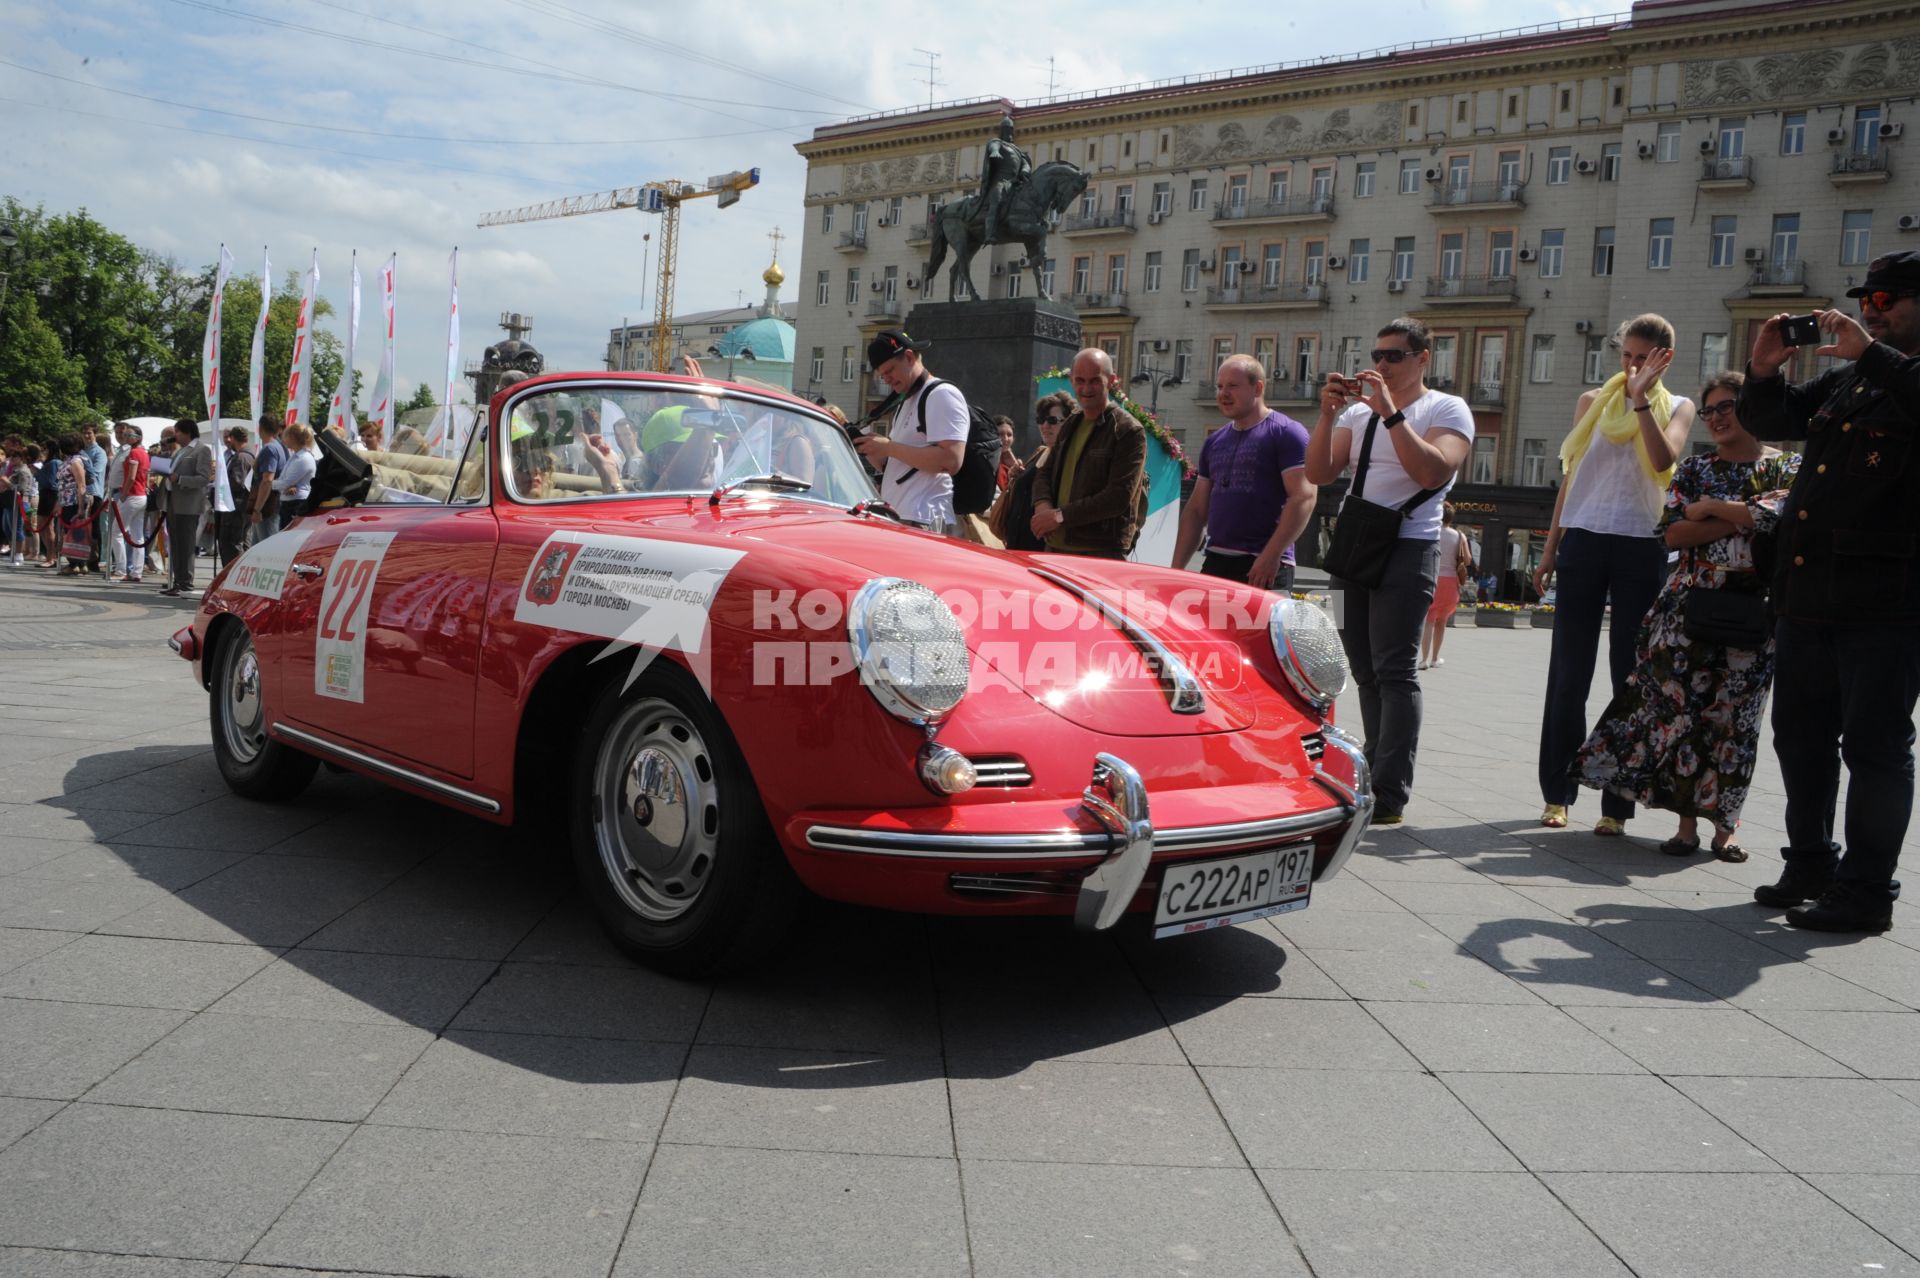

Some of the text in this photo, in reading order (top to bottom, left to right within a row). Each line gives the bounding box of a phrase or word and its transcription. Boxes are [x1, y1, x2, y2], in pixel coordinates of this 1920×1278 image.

[1456, 502, 1498, 513] МОСКВА
[581, 547, 642, 562] ДЕПАРТАМЕНТ
[235, 566, 285, 593] TATNEFT
[574, 560, 672, 583] ПРИРОДОПОЛЬЗОВАНИЯ
[320, 559, 377, 641] 22
[562, 590, 631, 612] ГОРОДА МОСКВЫ
[568, 574, 708, 605] И ОХРАНЫ ОКРУЖАЮЩЕЙ СРЕДЫ
[1277, 850, 1309, 884] 197
[1280, 883, 1296, 896] RUS
